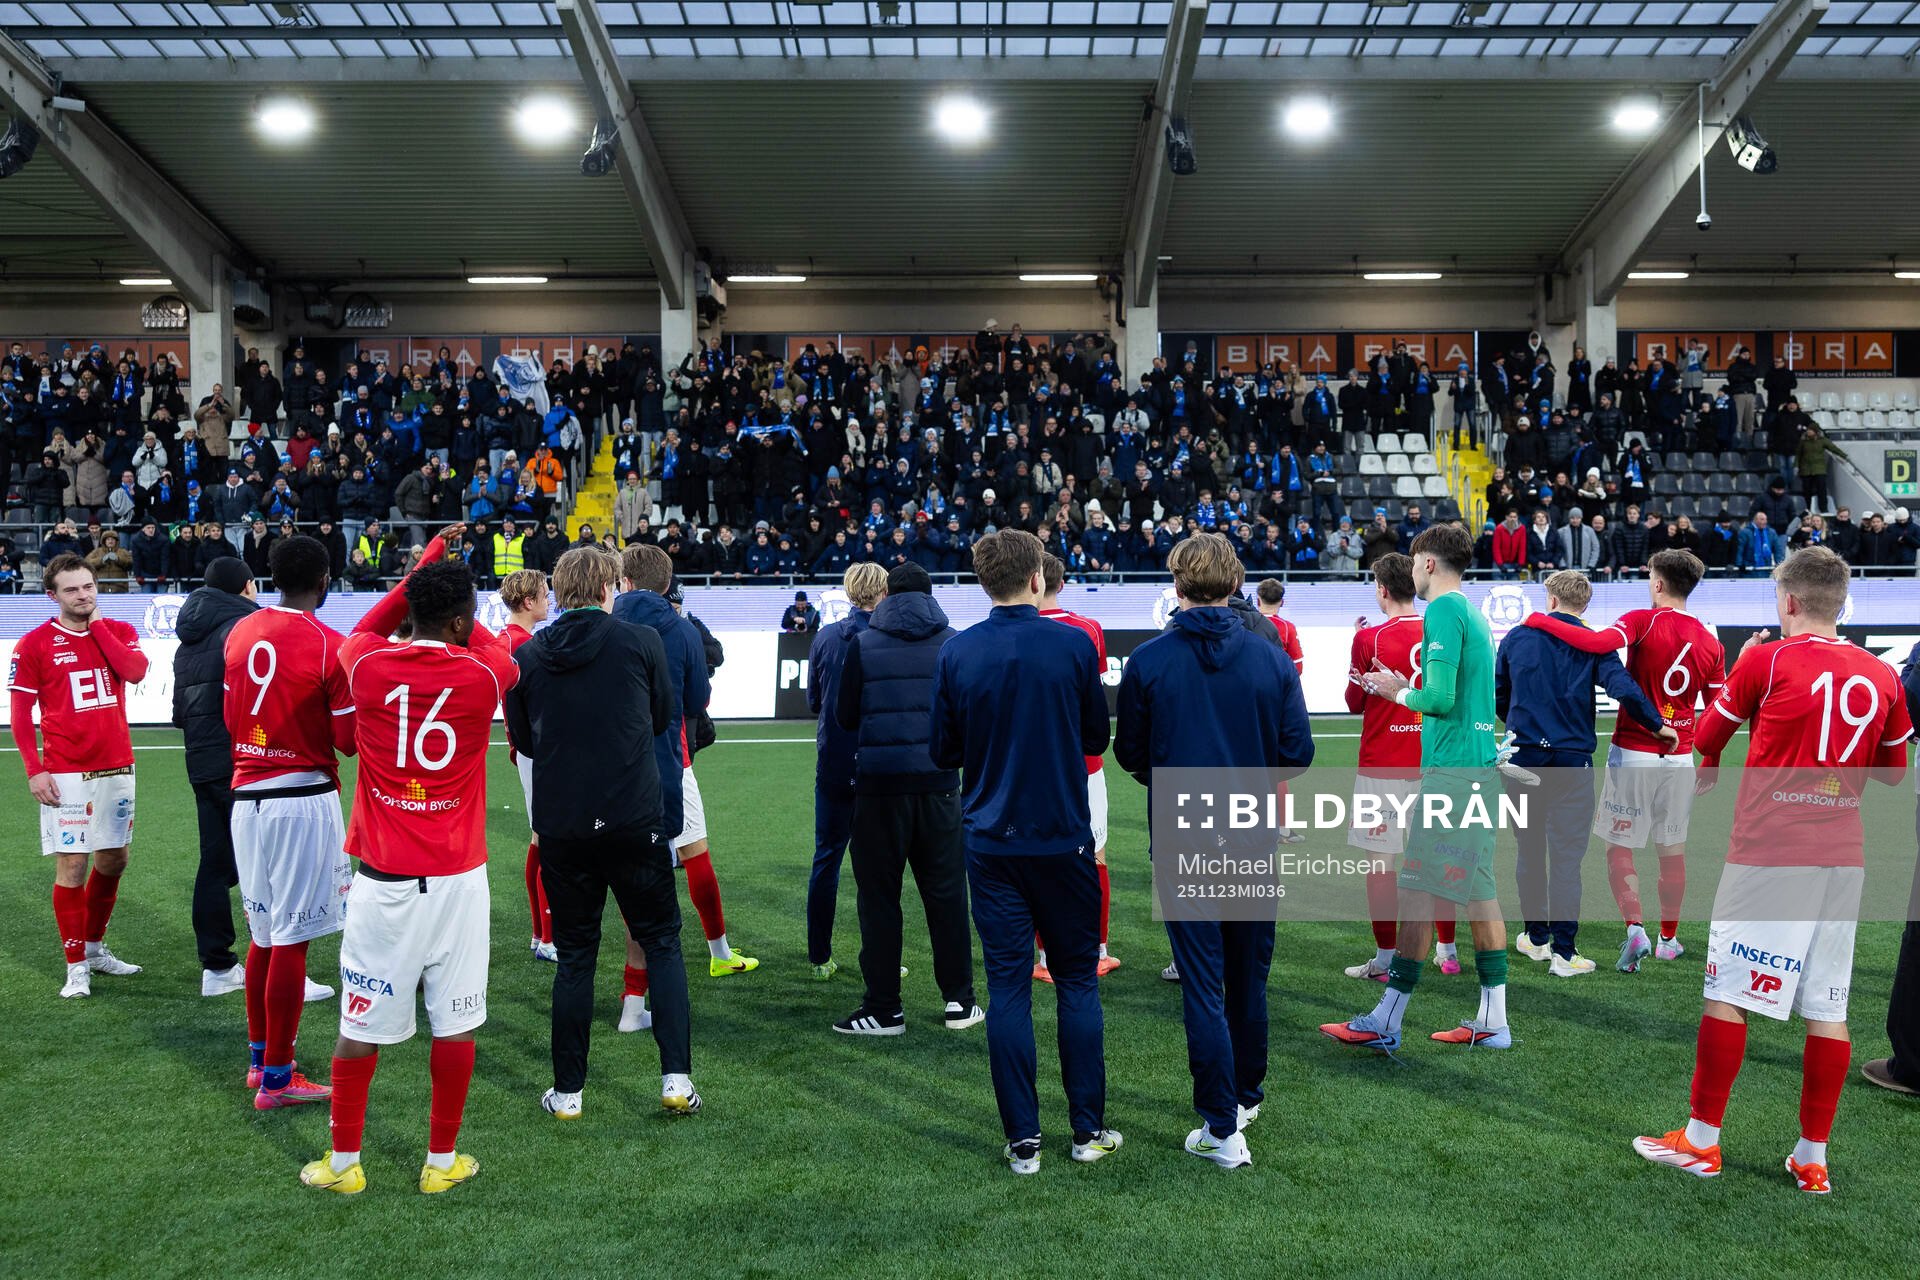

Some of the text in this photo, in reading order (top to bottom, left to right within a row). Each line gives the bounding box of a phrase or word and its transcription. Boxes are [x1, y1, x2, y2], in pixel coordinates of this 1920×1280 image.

[1227, 345, 1331, 362] BRA
[1783, 342, 1887, 359] BRA
[1886, 450, 1916, 458] SEKTION
[1892, 460, 1910, 482] D
[247, 640, 277, 716] 9
[1663, 642, 1692, 697] 6
[69, 668, 117, 710] EL
[384, 684, 457, 771] 16
[1475, 722, 1494, 731] OLOF
[1811, 671, 1879, 763] 19
[1390, 724, 1423, 732] OLOFSSO
[235, 743, 296, 758] FSSON BYGG
[429, 798, 460, 811] BYGG
[1772, 790, 1836, 807] OLOFSSON
[80, 831, 86, 844] 4
[1434, 842, 1481, 863] INSECT
[288, 903, 329, 924] ERLA
[1730, 941, 1801, 973] INSECTA
[342, 966, 394, 996] INSECTA
